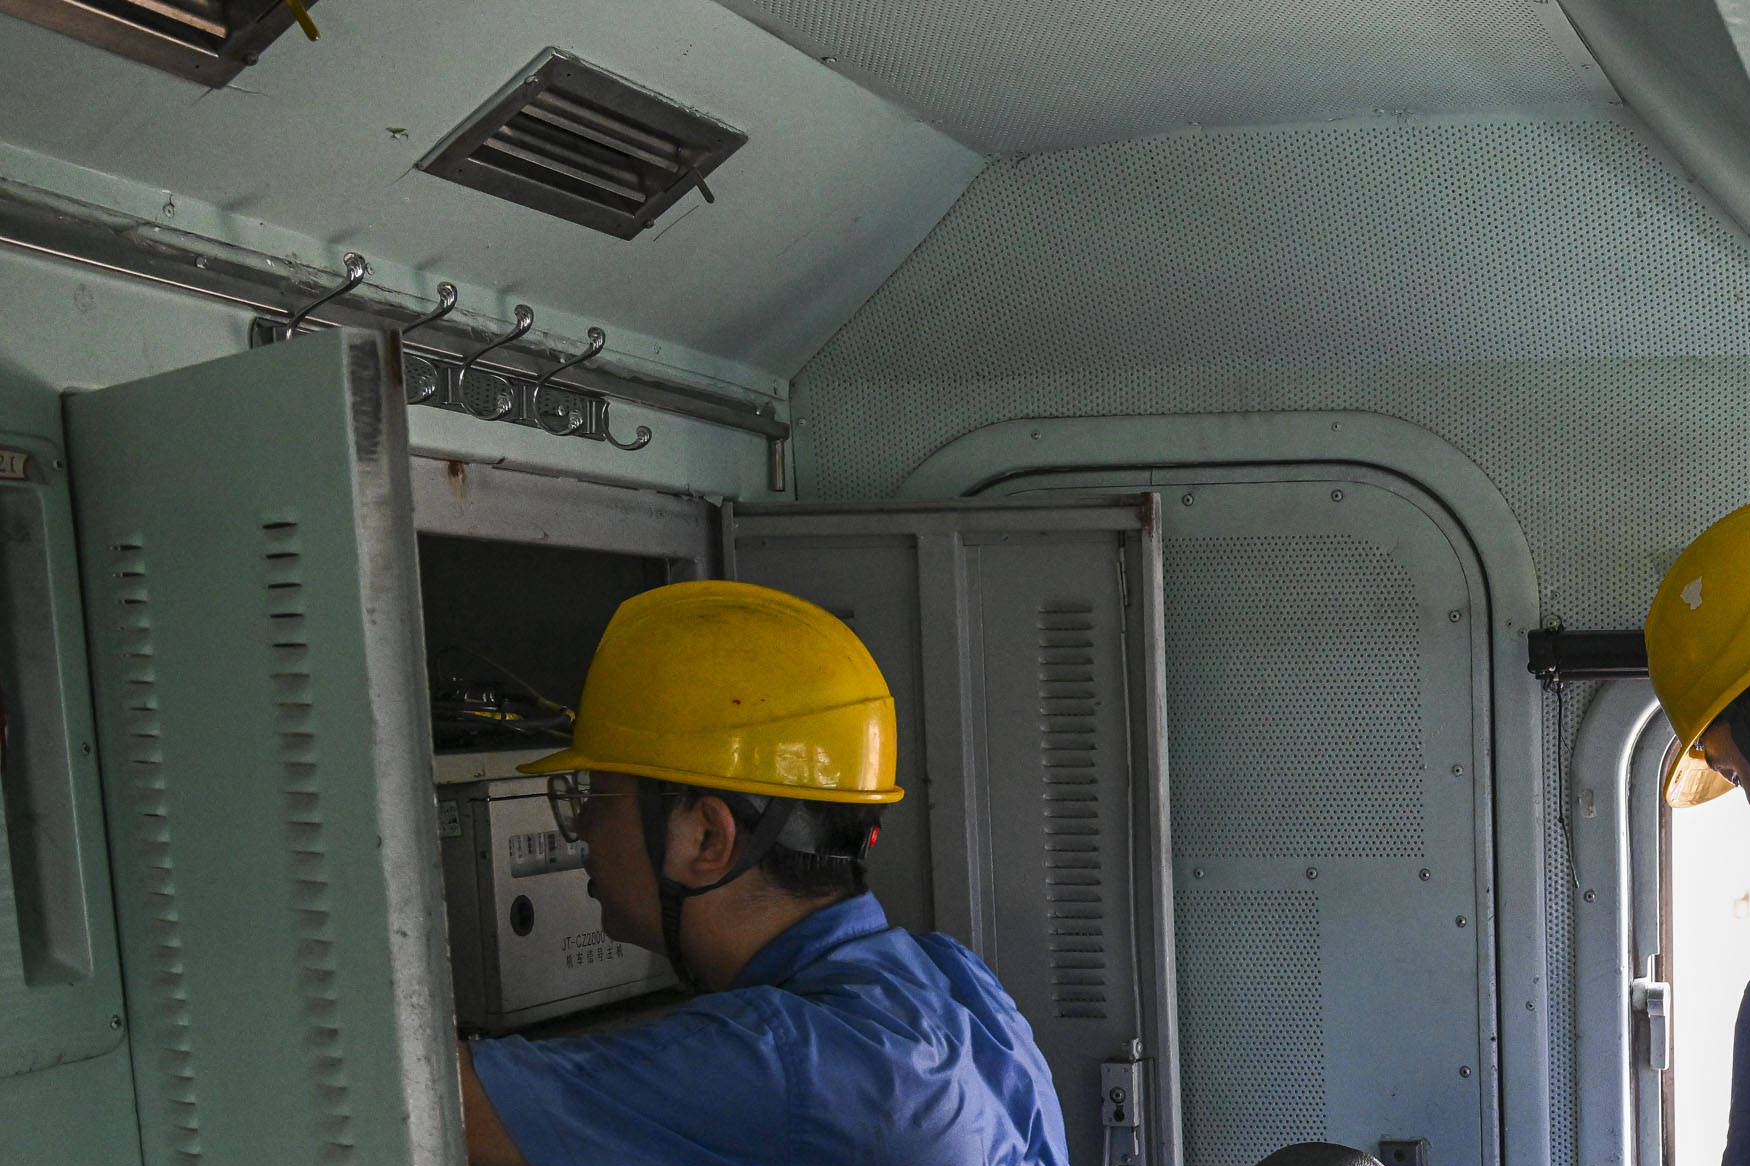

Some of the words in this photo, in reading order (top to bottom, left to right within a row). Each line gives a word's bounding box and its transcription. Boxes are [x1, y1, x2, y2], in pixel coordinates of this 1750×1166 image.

[566, 944, 624, 968] 机车信号主机
